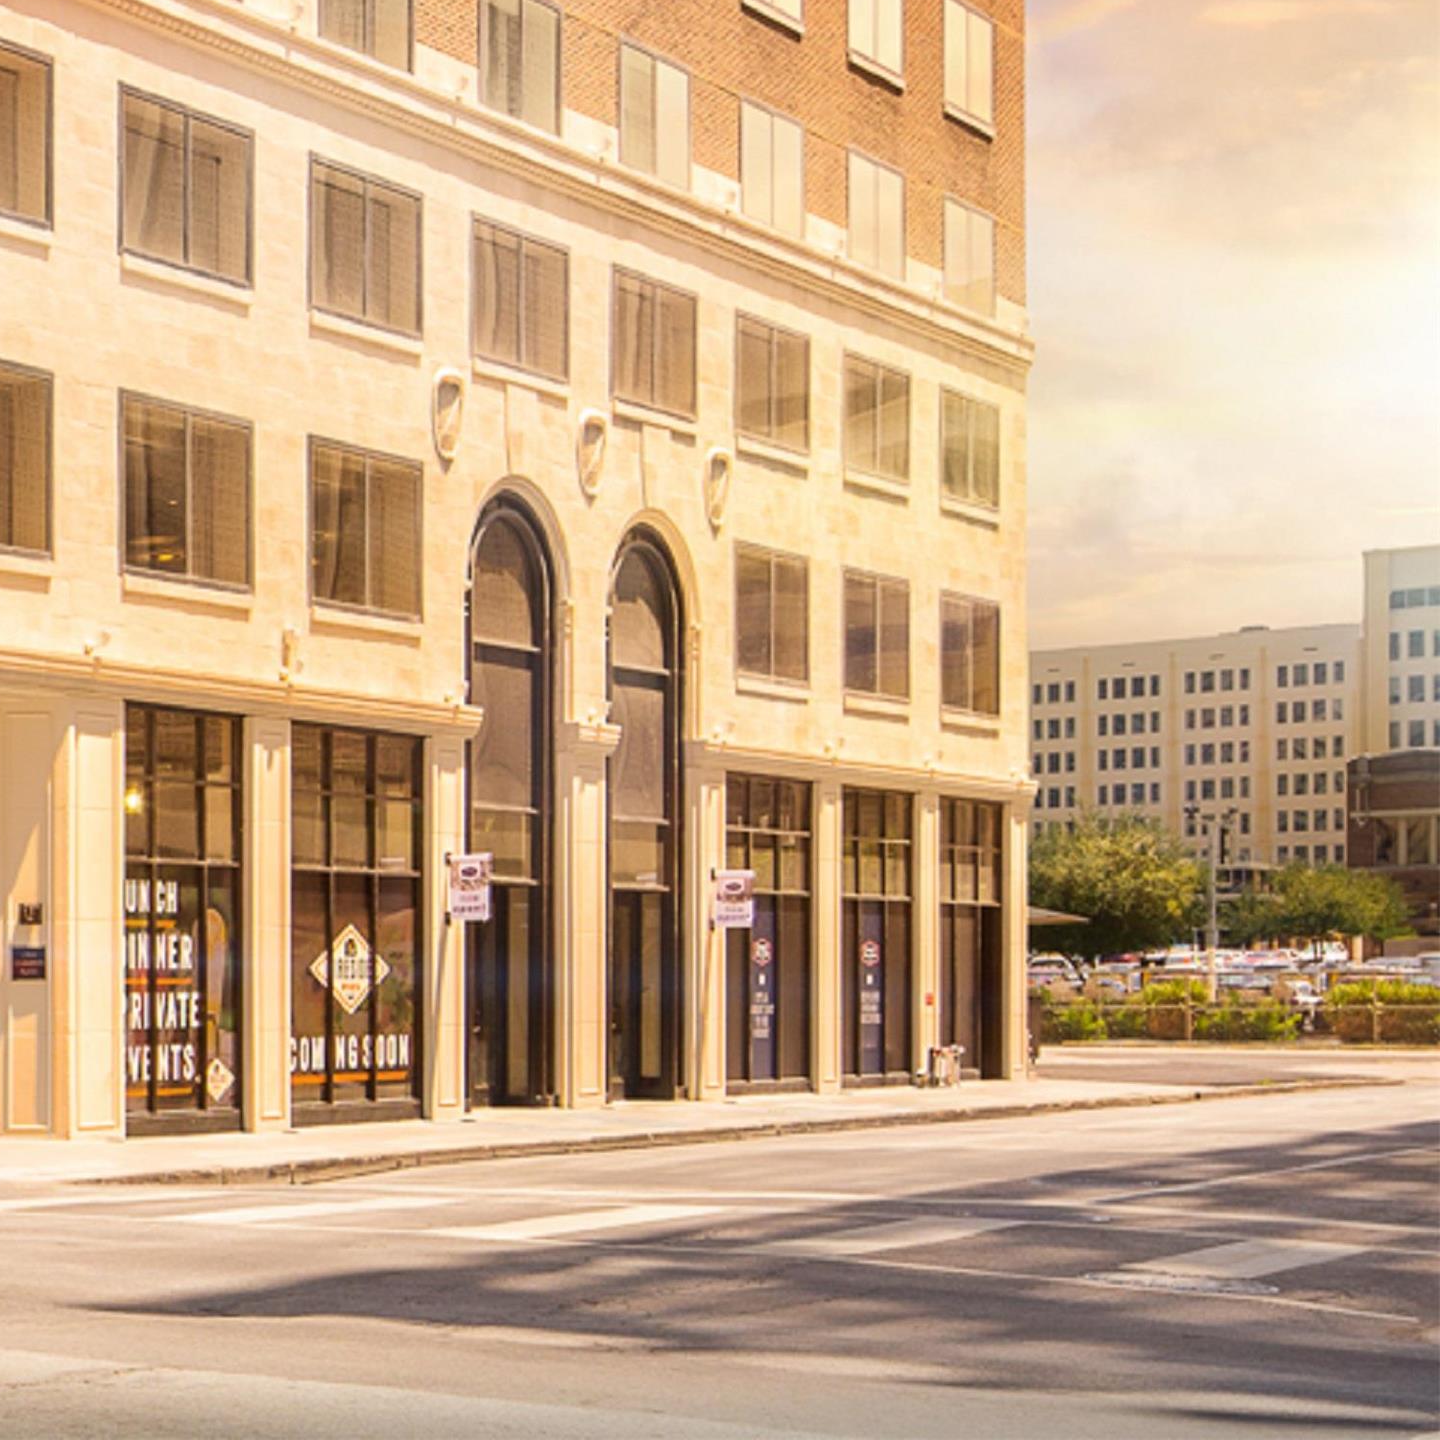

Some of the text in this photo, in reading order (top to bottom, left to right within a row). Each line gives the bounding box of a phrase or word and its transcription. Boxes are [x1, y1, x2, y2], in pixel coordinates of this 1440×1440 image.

[124, 879, 178, 913] UNCH
[123, 933, 193, 970] INNER
[125, 1043, 196, 1083] VENTS
[290, 1034, 358, 1072] COMNG
